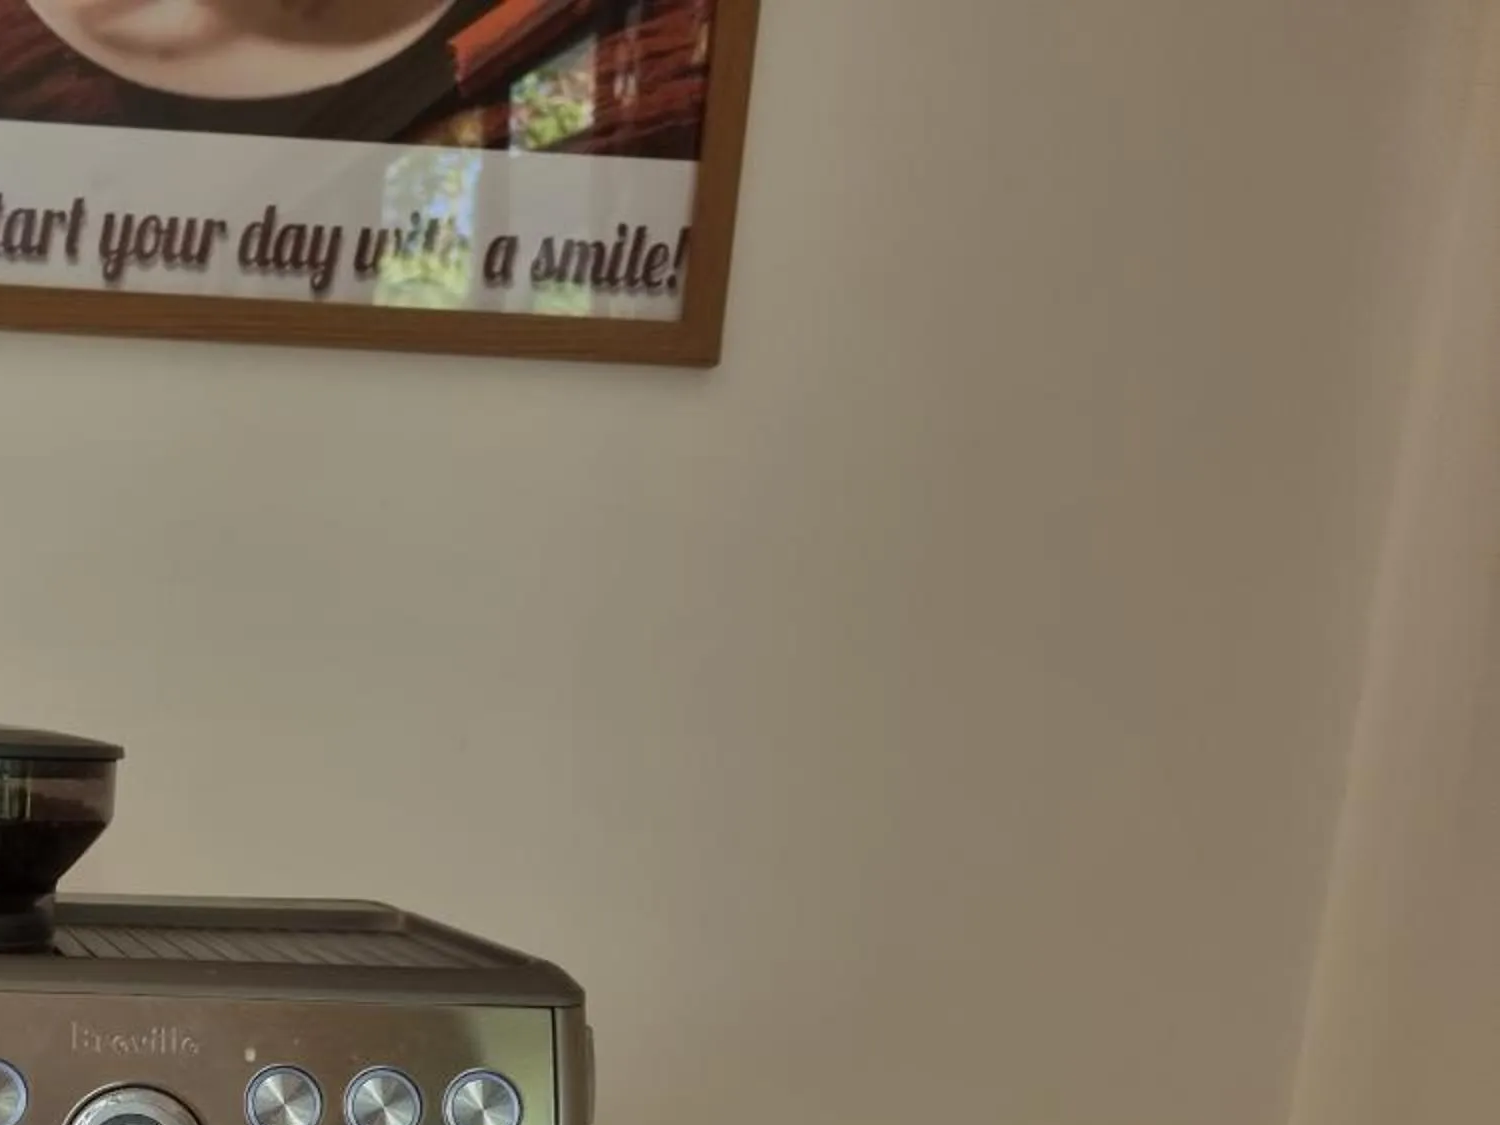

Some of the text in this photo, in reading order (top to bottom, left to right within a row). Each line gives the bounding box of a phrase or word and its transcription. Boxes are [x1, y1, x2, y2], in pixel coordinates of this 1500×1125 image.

[99, 212, 228, 284] your
[238, 204, 343, 292] day
[482, 234, 519, 286] a
[530, 222, 692, 290] smile!
